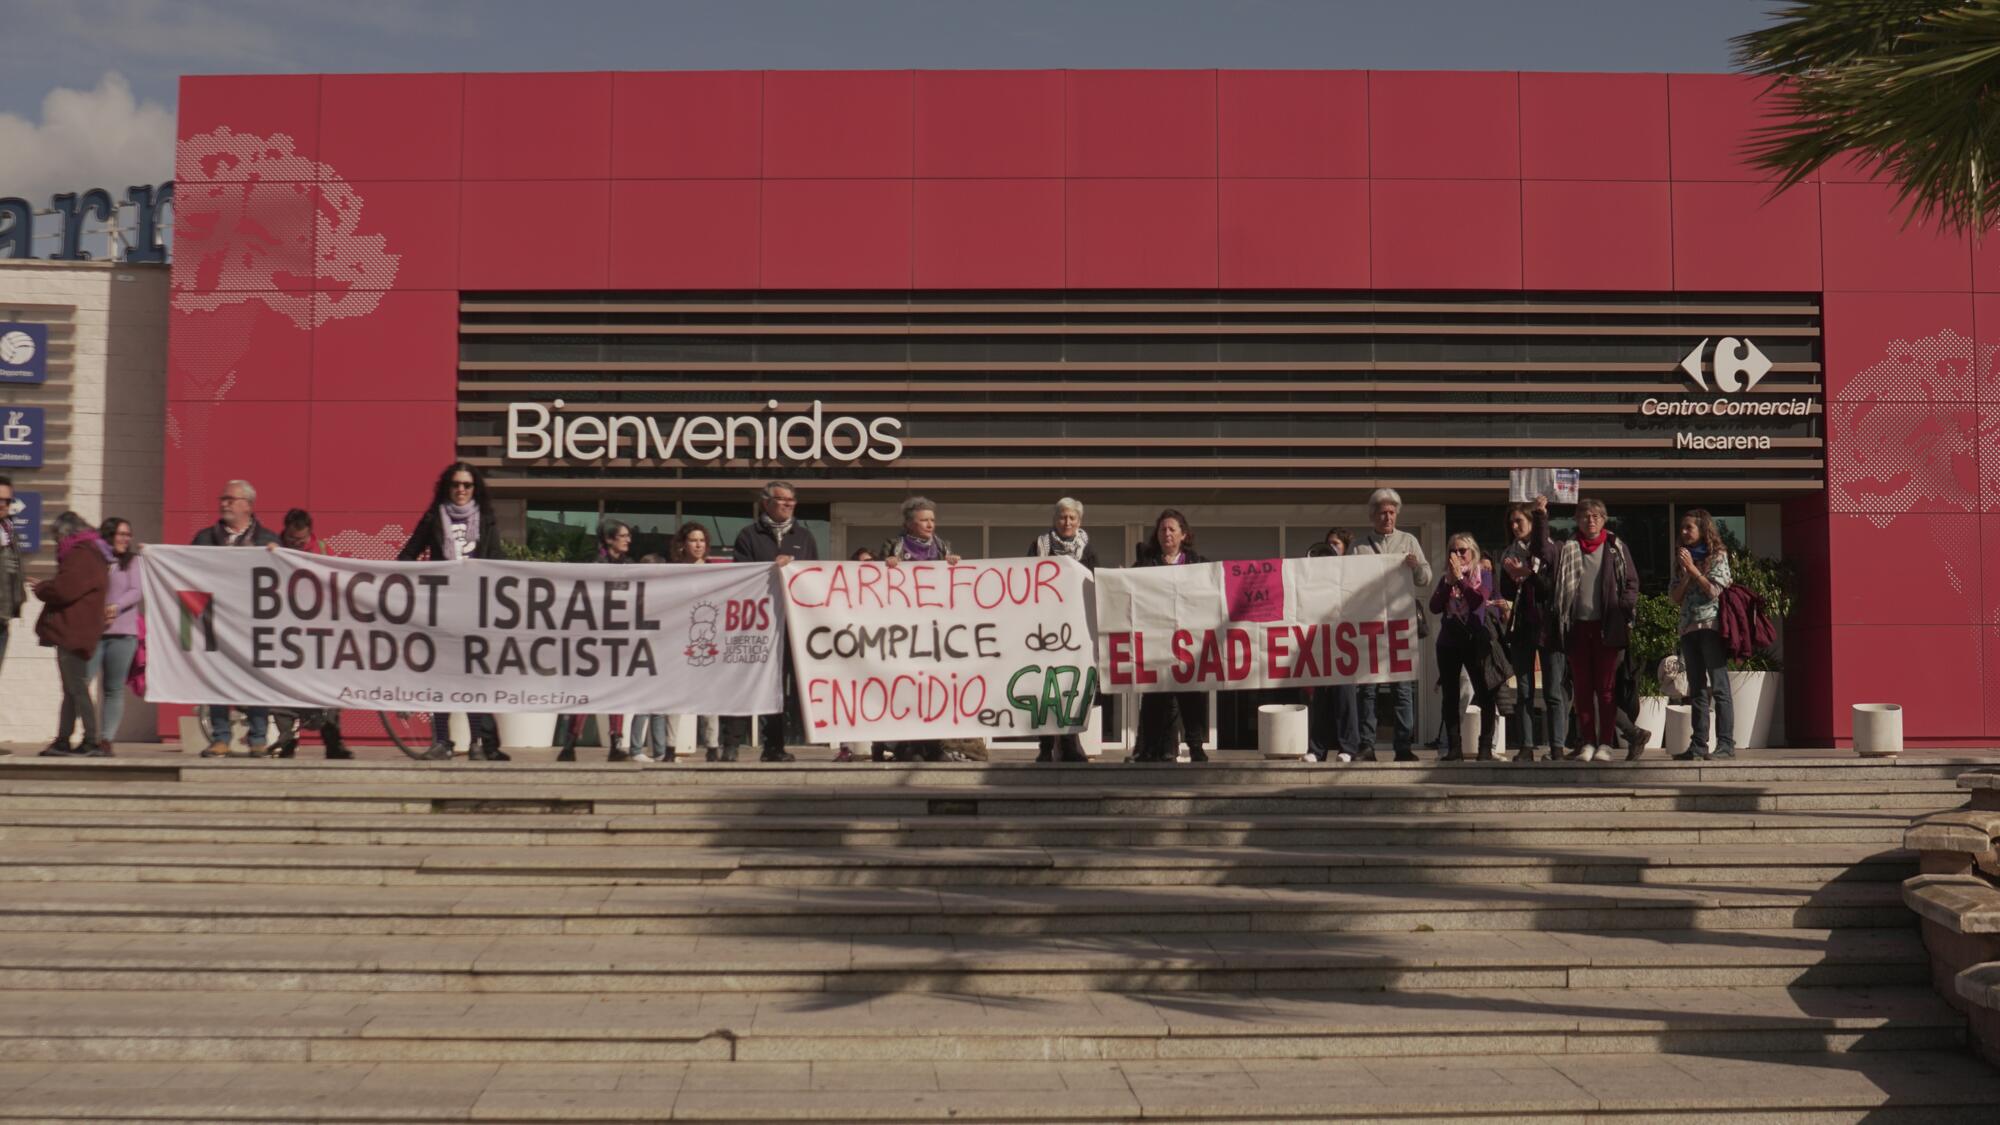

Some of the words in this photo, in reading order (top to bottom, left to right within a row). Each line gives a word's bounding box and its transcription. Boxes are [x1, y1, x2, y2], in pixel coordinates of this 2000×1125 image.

[1641, 398, 1708, 416] Centro
[1712, 397, 1812, 416] Comercial
[507, 399, 903, 461] Bienvenidos
[1676, 432, 1771, 449] Macarena
[788, 561, 1063, 609] CARREFOUR
[252, 566, 449, 627] BOICOT
[478, 575, 660, 631] ISRAEL
[725, 598, 769, 632] BDS
[725, 636, 769, 645] LIBERTAD
[1025, 622, 1081, 651] del
[252, 626, 435, 673] ESTADO
[463, 635, 658, 677] RACISTA
[723, 655, 768, 664] IGUALDAD
[724, 645, 769, 655] JUSTICIA
[1108, 631, 1157, 684] EL
[1171, 628, 1252, 683] SAD
[1267, 619, 1412, 679] EXISTE
[450, 692, 487, 704] con
[494, 690, 589, 705] Palestina
[978, 709, 1015, 729] en
